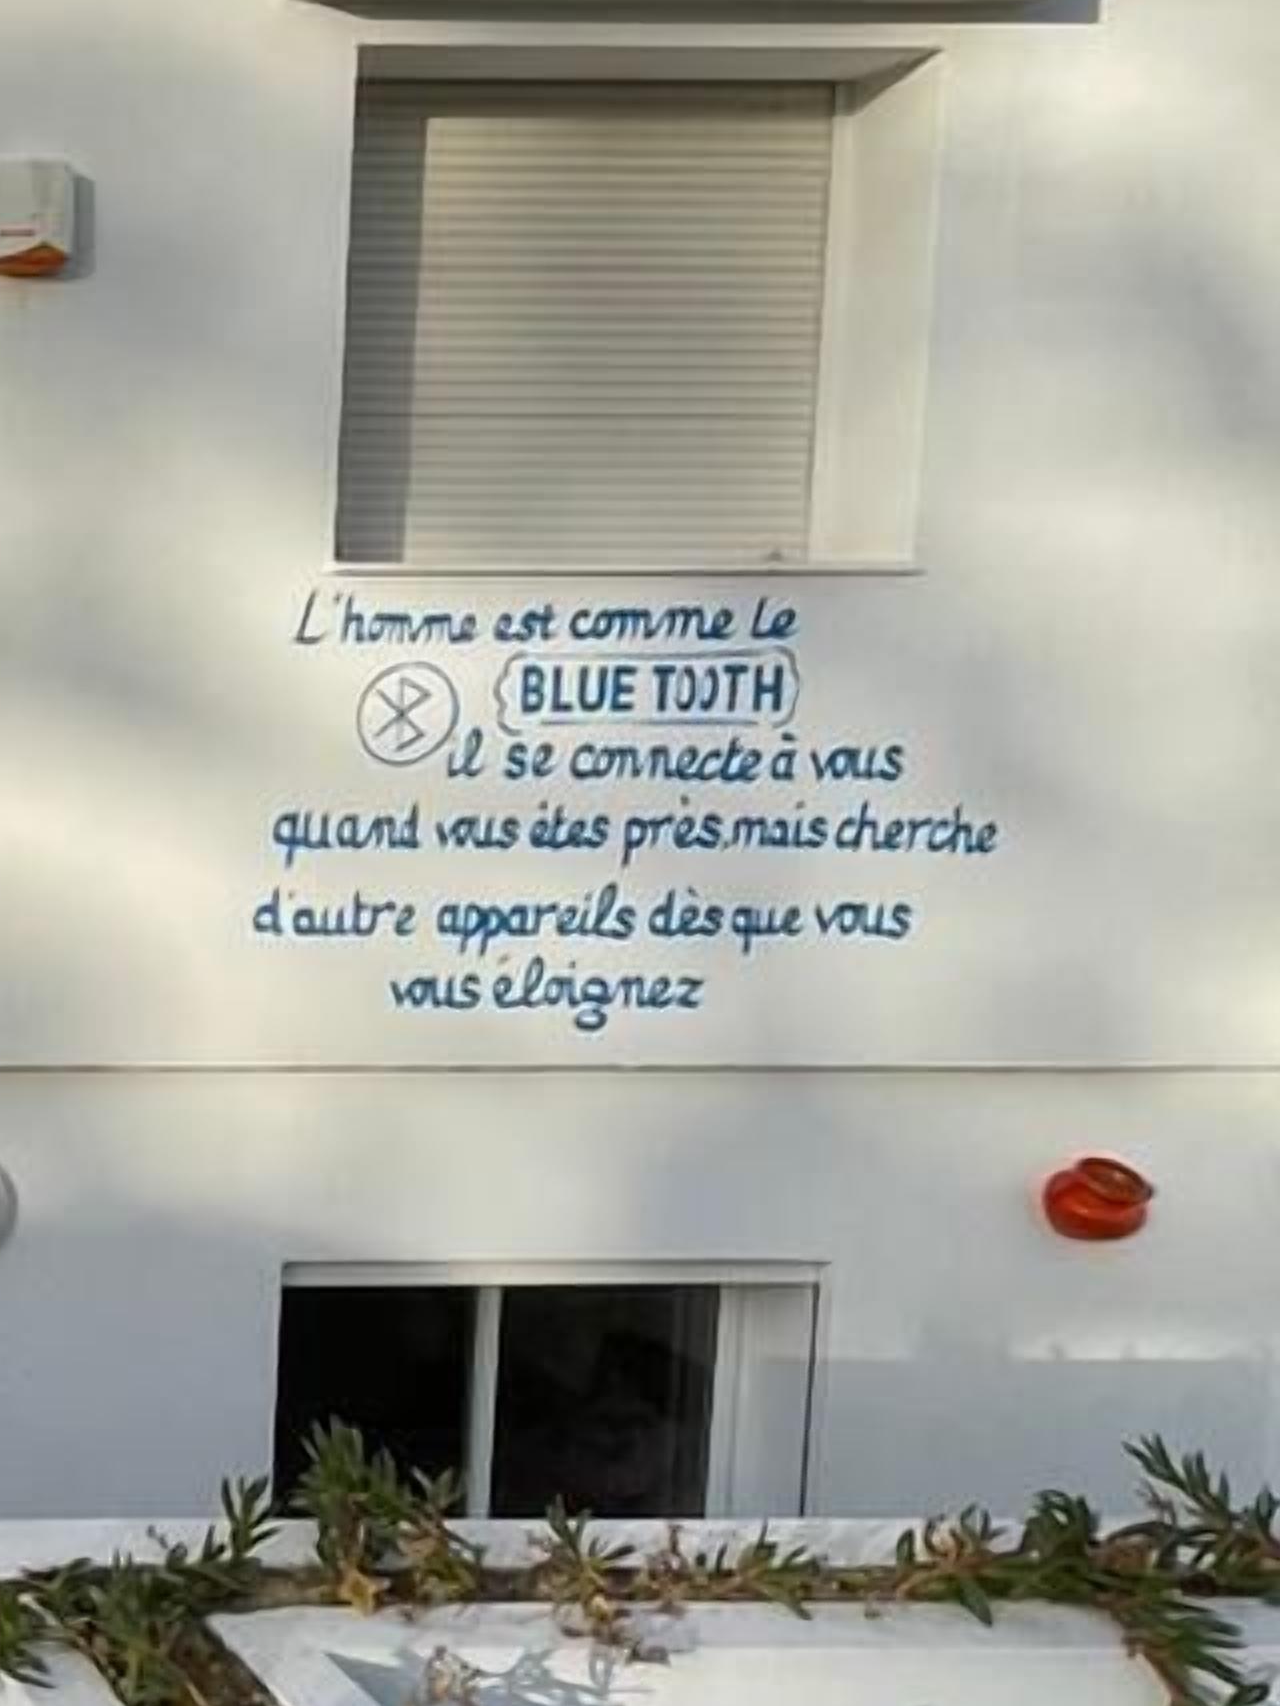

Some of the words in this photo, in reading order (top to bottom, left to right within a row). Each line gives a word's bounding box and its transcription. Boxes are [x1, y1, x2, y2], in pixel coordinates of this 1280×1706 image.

[295, 591, 476, 644] L'homme
[493, 605, 554, 641] est
[569, 606, 738, 640] comme
[520, 665, 636, 713] BLUE
[653, 665, 784, 713] TOOTH
[448, 727, 484, 778] il
[505, 743, 556, 779] se
[569, 736, 762, 781] connecte
[771, 731, 796, 780] à
[810, 744, 905, 781] vous
[273, 801, 420, 868] quand
[436, 816, 520, 849] vous
[733, 800, 829, 849] mais
[835, 800, 998, 853] cherche
[252, 886, 416, 936] d'autre
[436, 882, 637, 957] appareils
[648, 886, 725, 936] dès
[731, 903, 802, 956] que
[814, 903, 913, 939] vous
[389, 973, 481, 1009] vous
[491, 953, 706, 1031] éloignez
